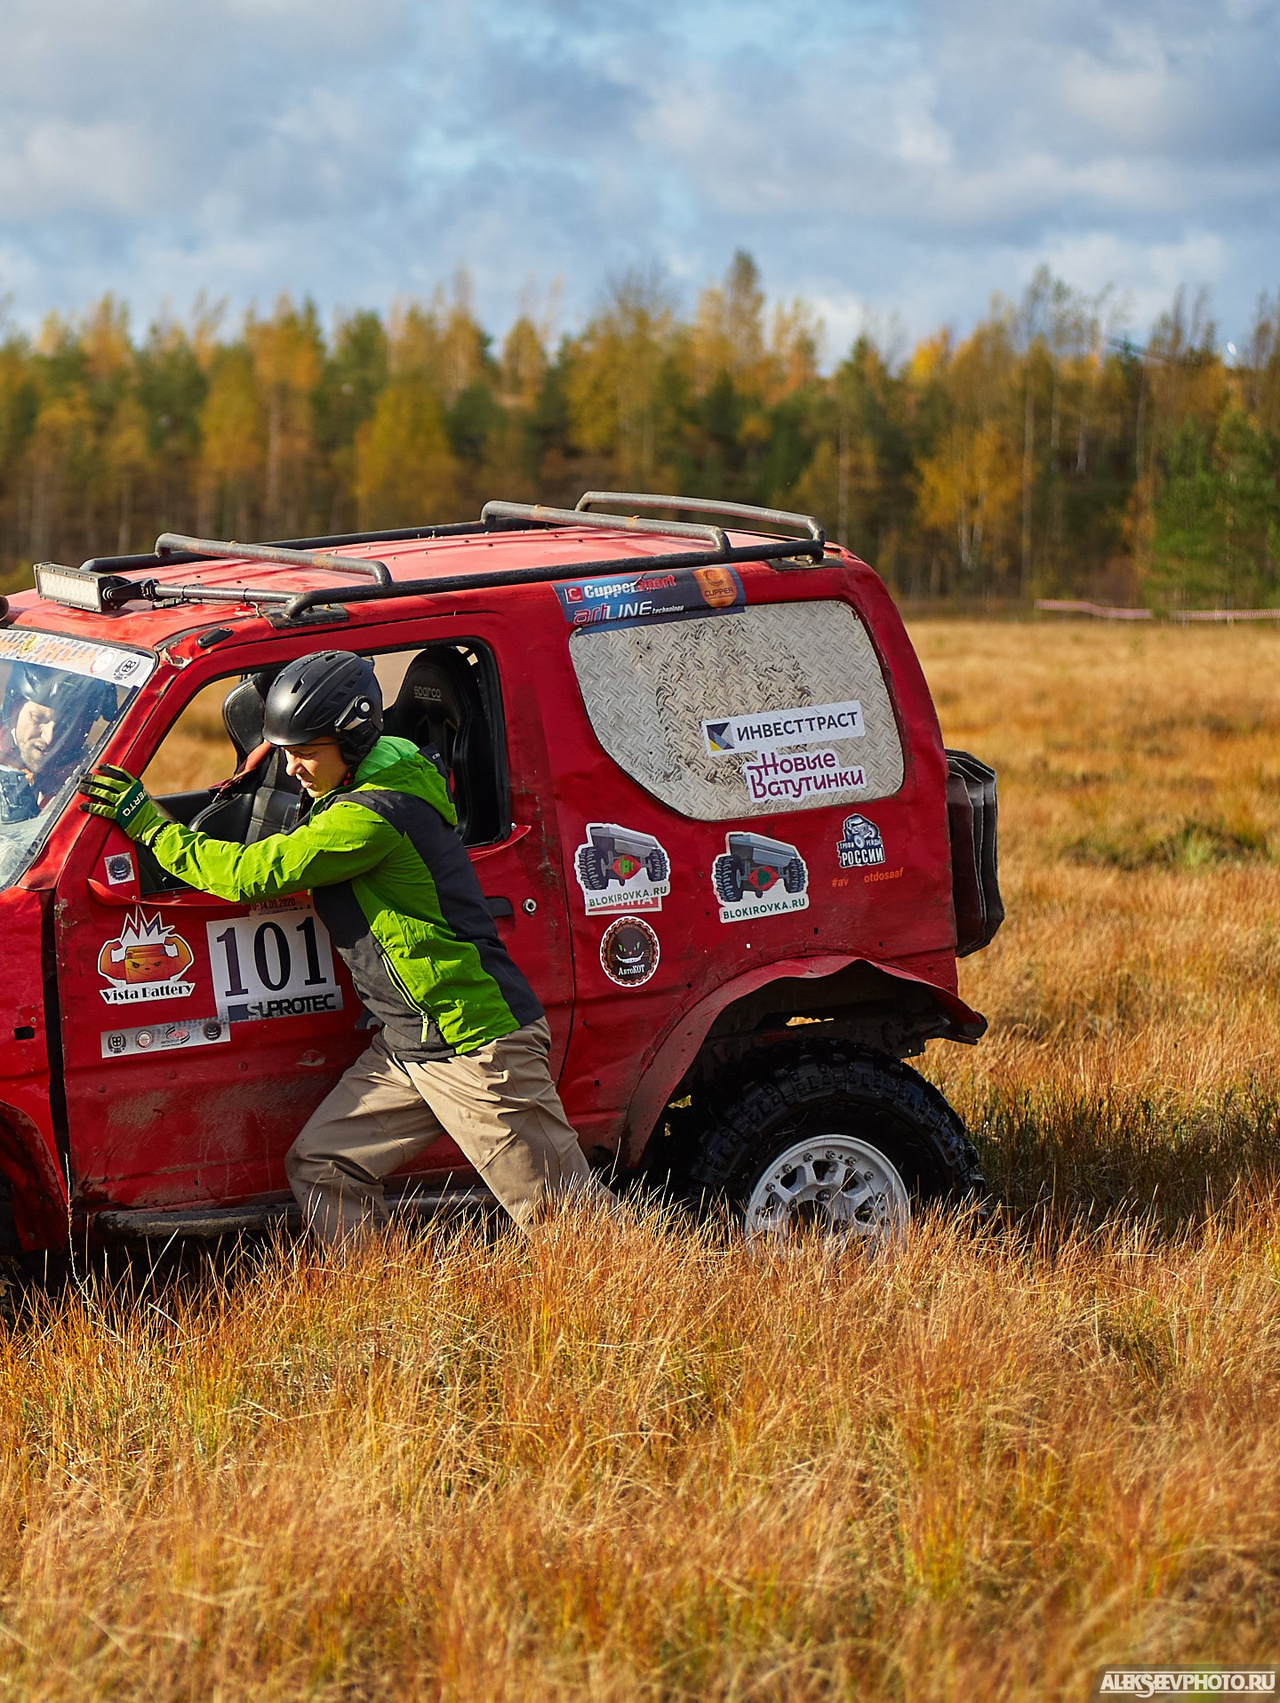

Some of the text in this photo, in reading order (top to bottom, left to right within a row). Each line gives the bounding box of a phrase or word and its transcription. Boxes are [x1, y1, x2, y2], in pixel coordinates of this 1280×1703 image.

[704, 587, 734, 597] CUPPER
[652, 604, 685, 615] technology
[413, 685, 441, 699] sparco
[736, 711, 858, 742] ИНВЕСТТРАСТ
[750, 752, 836, 777] Новые
[750, 768, 865, 799] Ватутинки
[841, 848, 884, 866] РОССИИ
[589, 886, 667, 907] BLOKIROVKA.RU
[723, 898, 806, 919] BLOKIROVKA.RU
[216, 916, 327, 997] 101
[103, 985, 194, 1002] Vista Battery
[247, 993, 336, 1018] SUPROTEC
